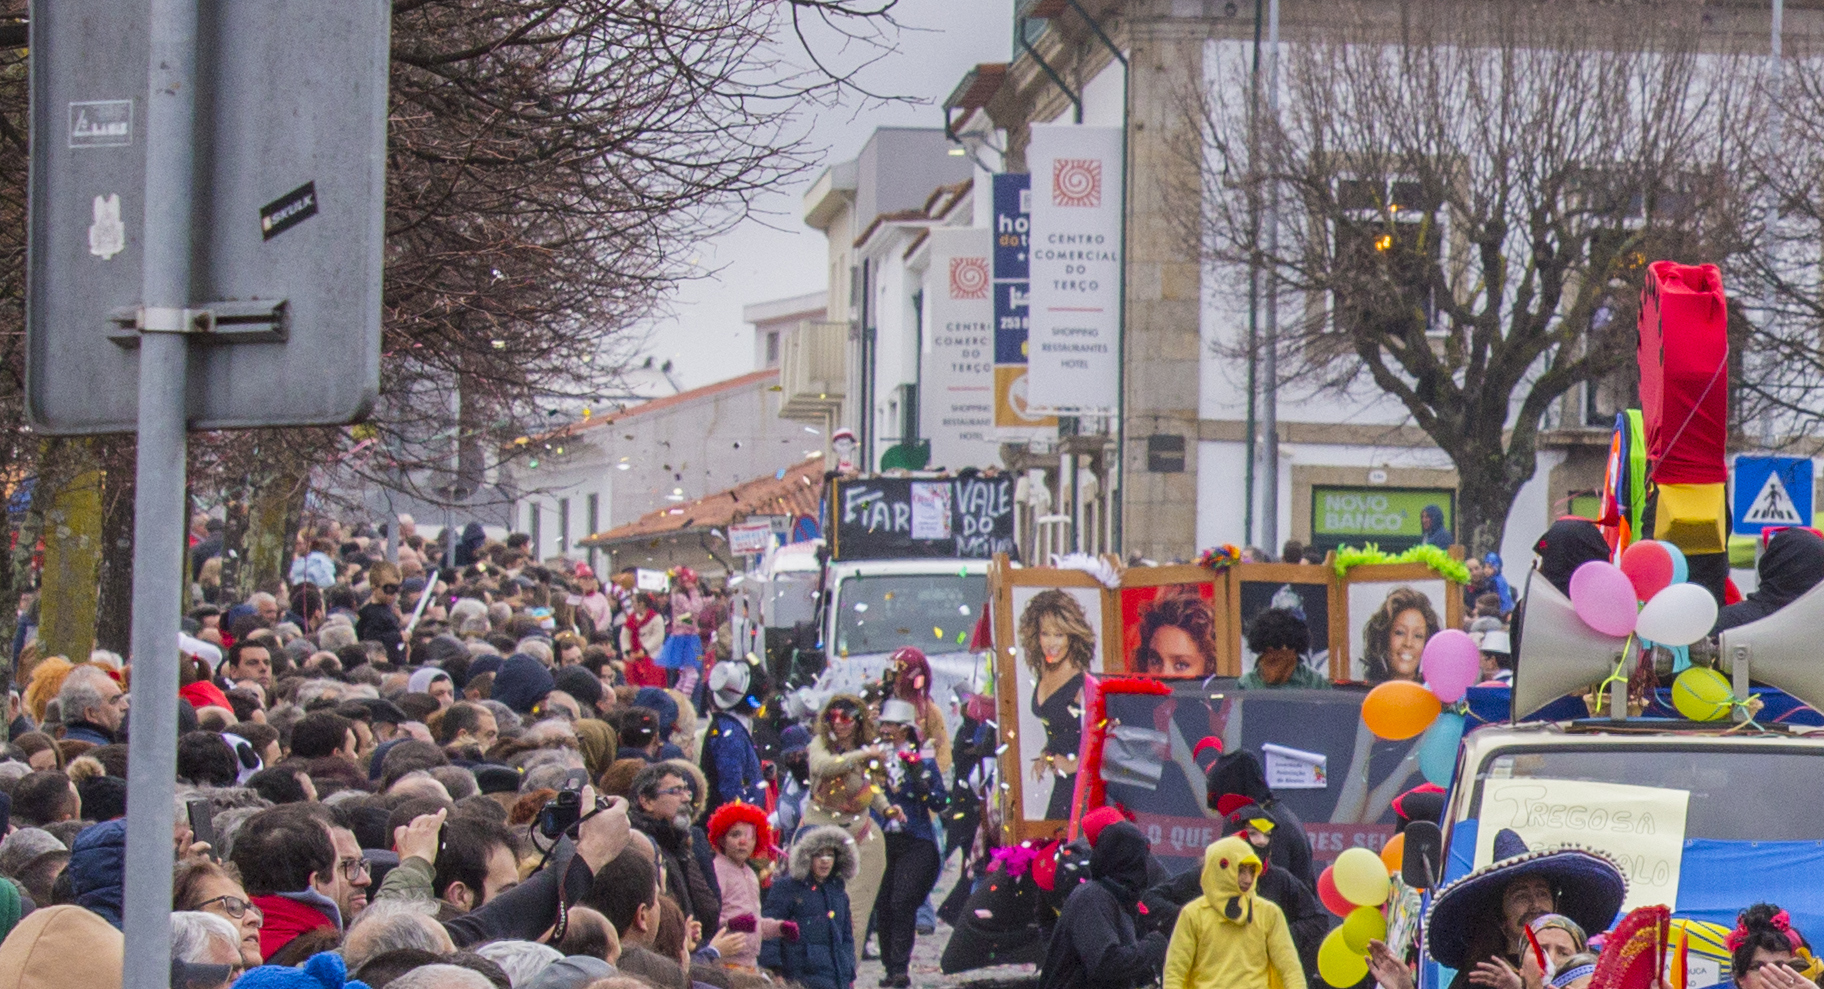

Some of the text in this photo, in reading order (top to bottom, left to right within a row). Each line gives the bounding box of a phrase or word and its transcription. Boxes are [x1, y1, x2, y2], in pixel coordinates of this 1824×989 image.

[1048, 234, 1105, 244] CENTRO
[1035, 250, 1117, 262] COMERCIAL
[1065, 264, 1086, 275] DO
[1053, 280, 1099, 292] TERÇO
[946, 322, 991, 332] CENTR
[1051, 327, 1099, 337] SHOPPING
[962, 349, 981, 359] DO
[1041, 343, 1108, 353] RESTAURANTES
[951, 363, 992, 375] TERÇO
[1061, 359, 1089, 369] HOTEL
[955, 479, 1011, 518] VALE
[1324, 494, 1388, 511] NOVO
[963, 516, 994, 536] DO
[1324, 513, 1402, 531] BANCO
[1493, 784, 1656, 836] TREGOSA
[1170, 825, 1213, 849] QUE
